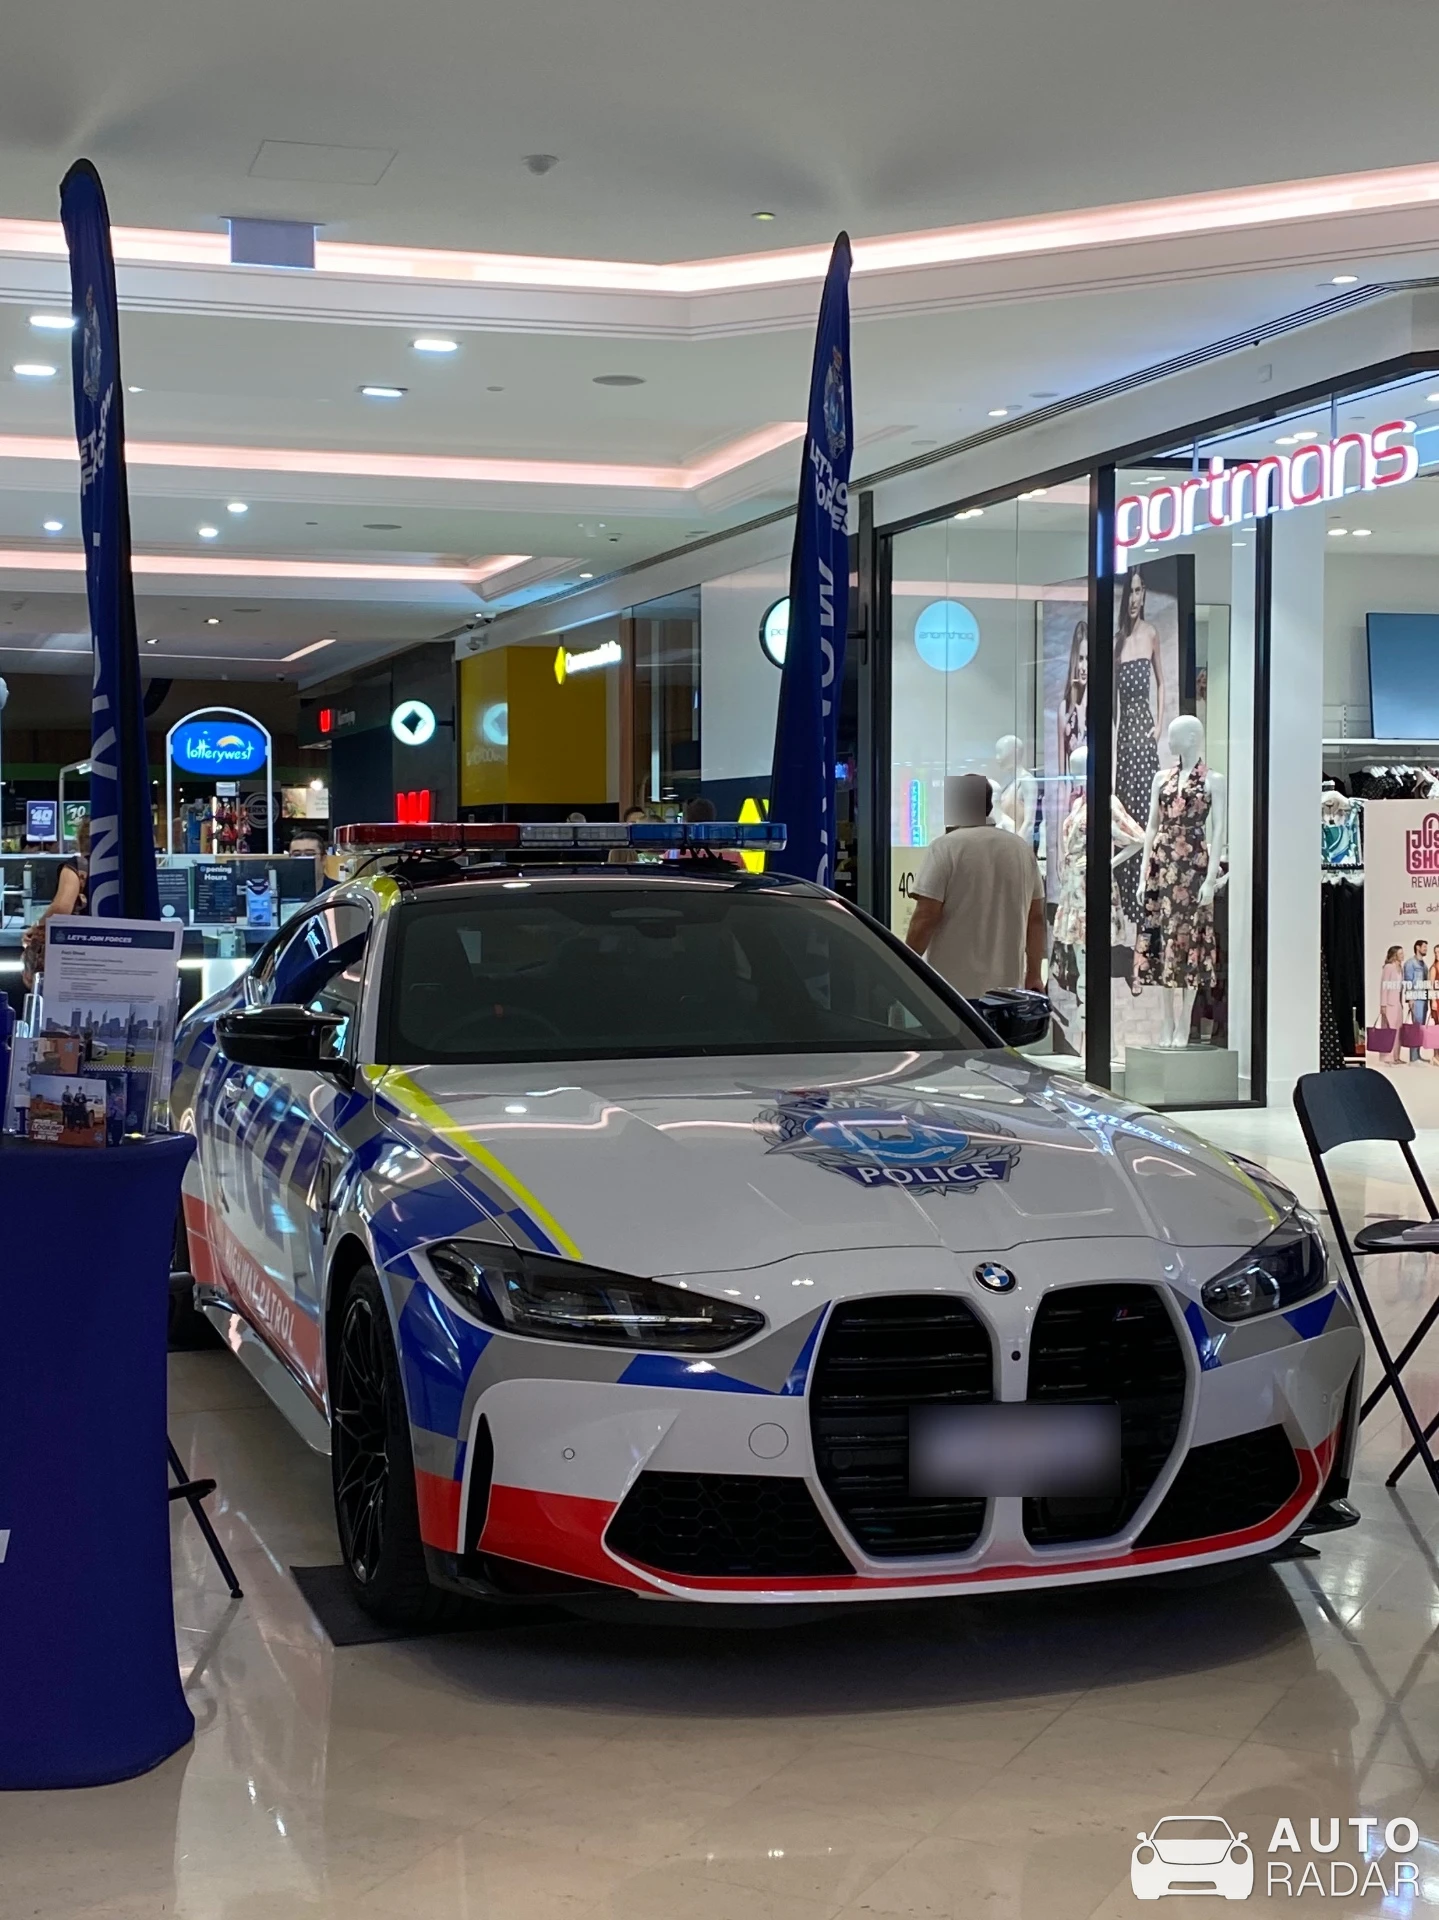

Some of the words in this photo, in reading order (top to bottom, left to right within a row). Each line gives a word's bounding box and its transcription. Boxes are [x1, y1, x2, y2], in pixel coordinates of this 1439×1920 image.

[1114, 420, 1420, 574] portmans
[187, 738, 254, 763] lotterywest
[200, 865, 233, 874] Opening
[1399, 908, 1419, 916] Jeans
[1402, 901, 1417, 909] Just
[1393, 919, 1432, 927] portmans
[856, 1162, 1002, 1185] POLICE
[258, 1281, 295, 1348] PATROL
